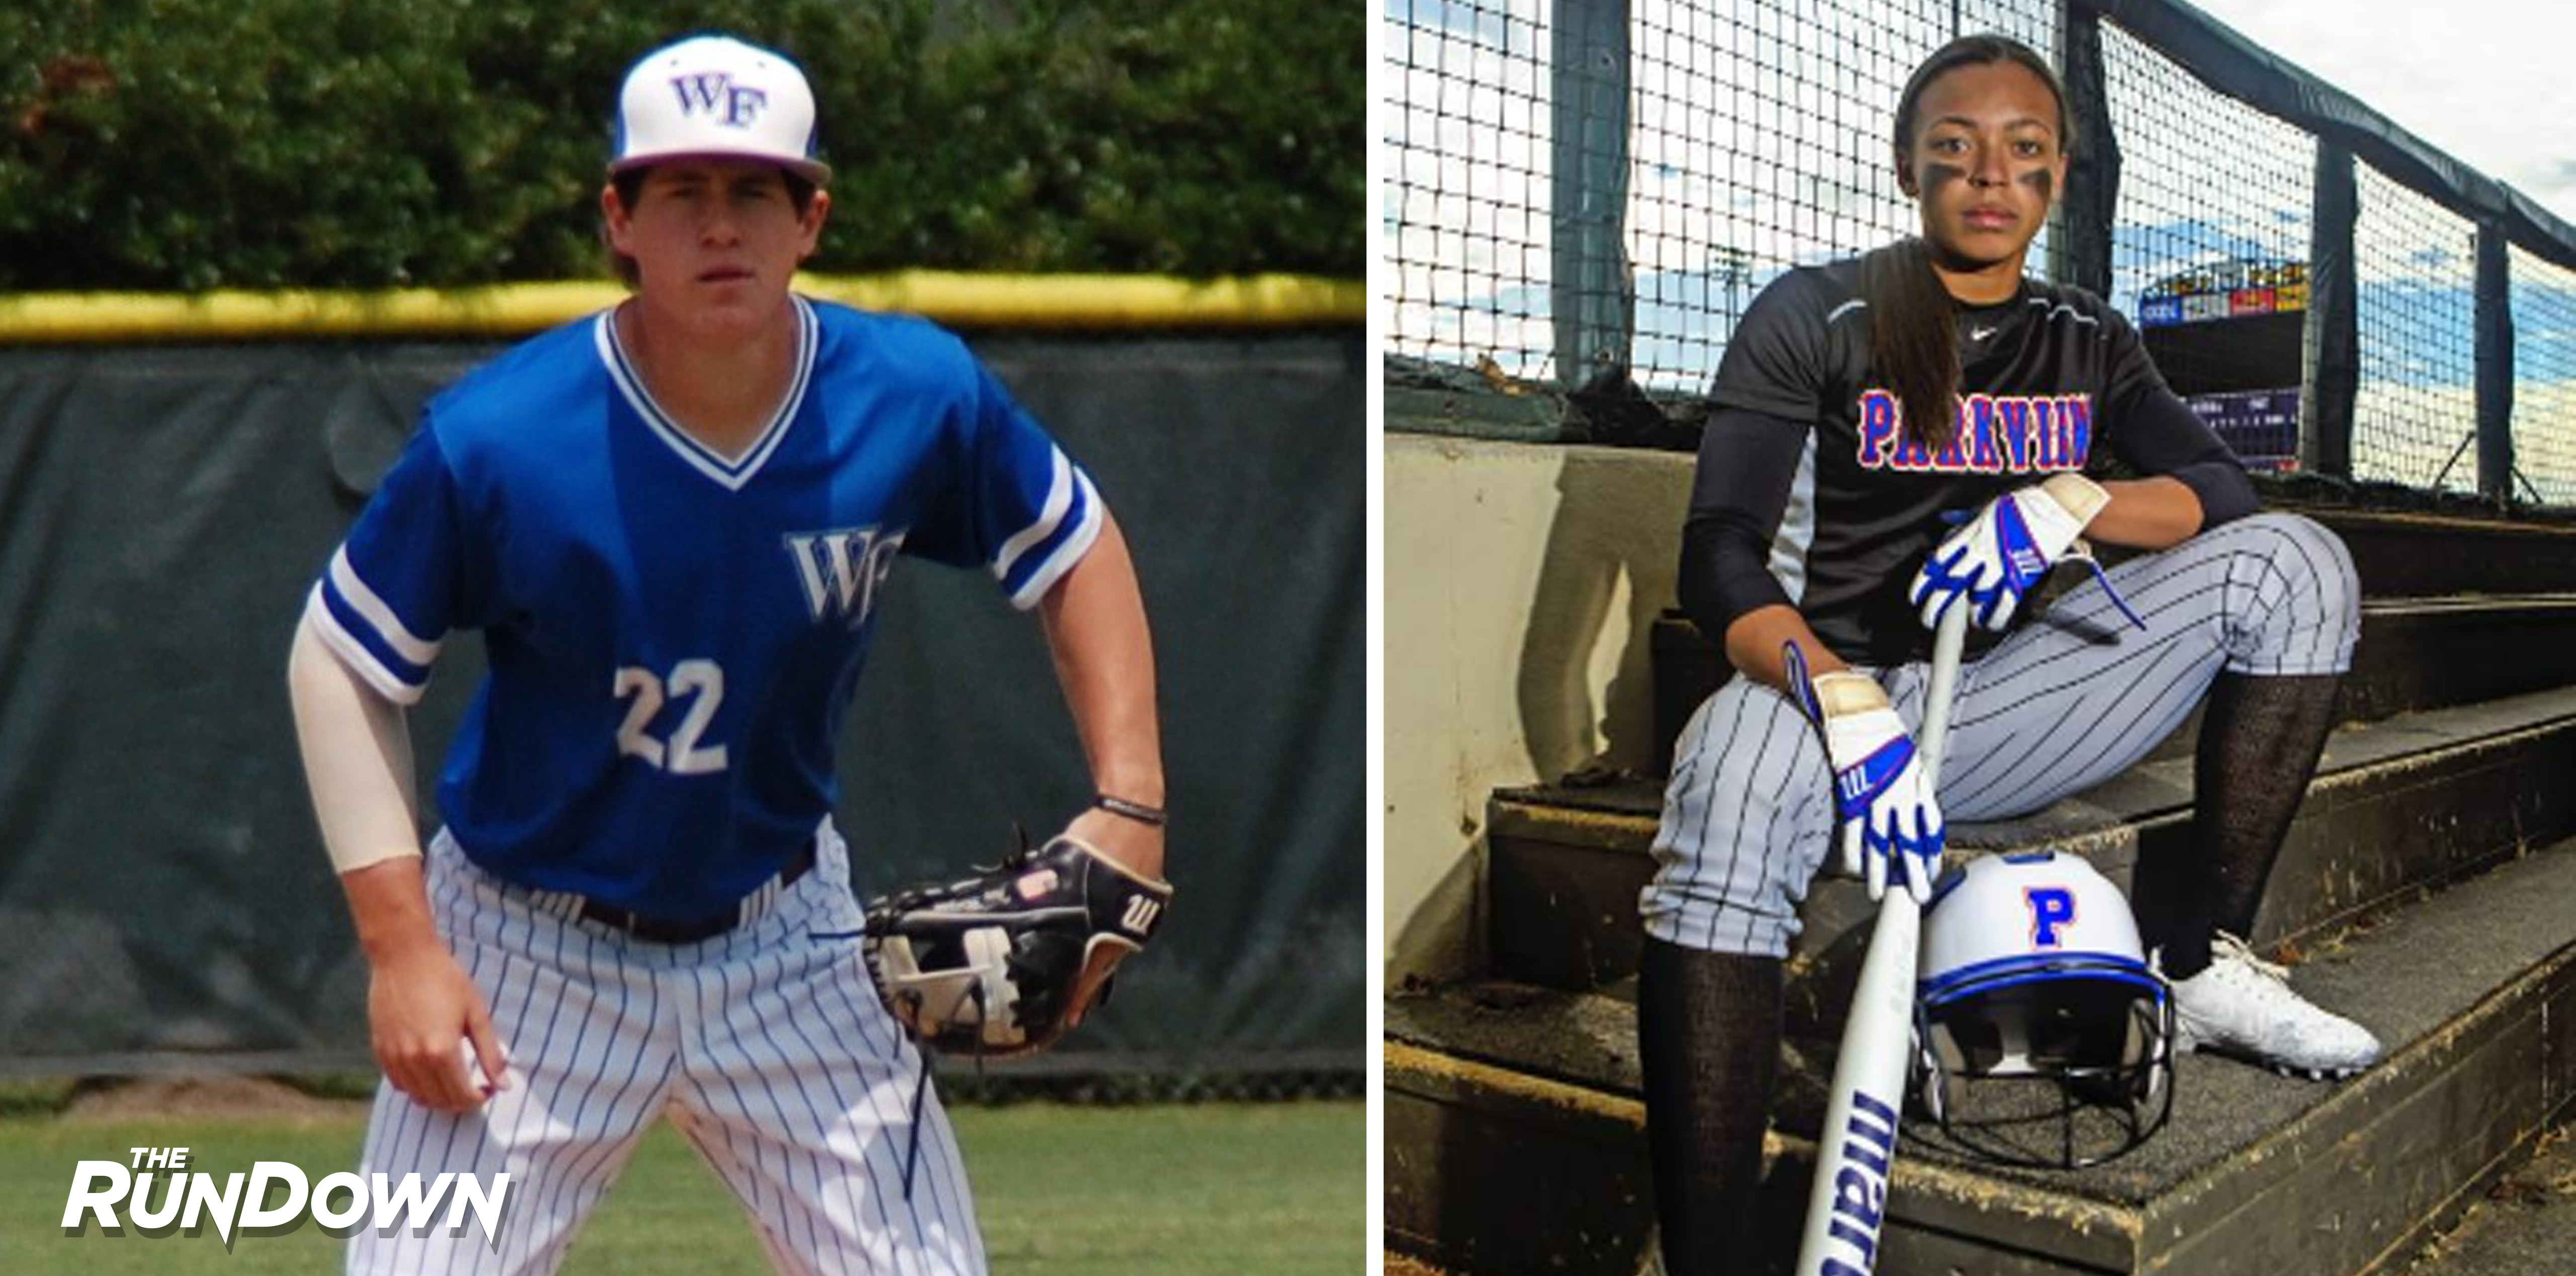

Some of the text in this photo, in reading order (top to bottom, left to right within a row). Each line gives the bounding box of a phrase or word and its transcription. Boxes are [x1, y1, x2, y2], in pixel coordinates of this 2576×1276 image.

[669, 71, 767, 129] WF
[613, 659, 728, 774] 22
[2024, 886, 2077, 950] P
